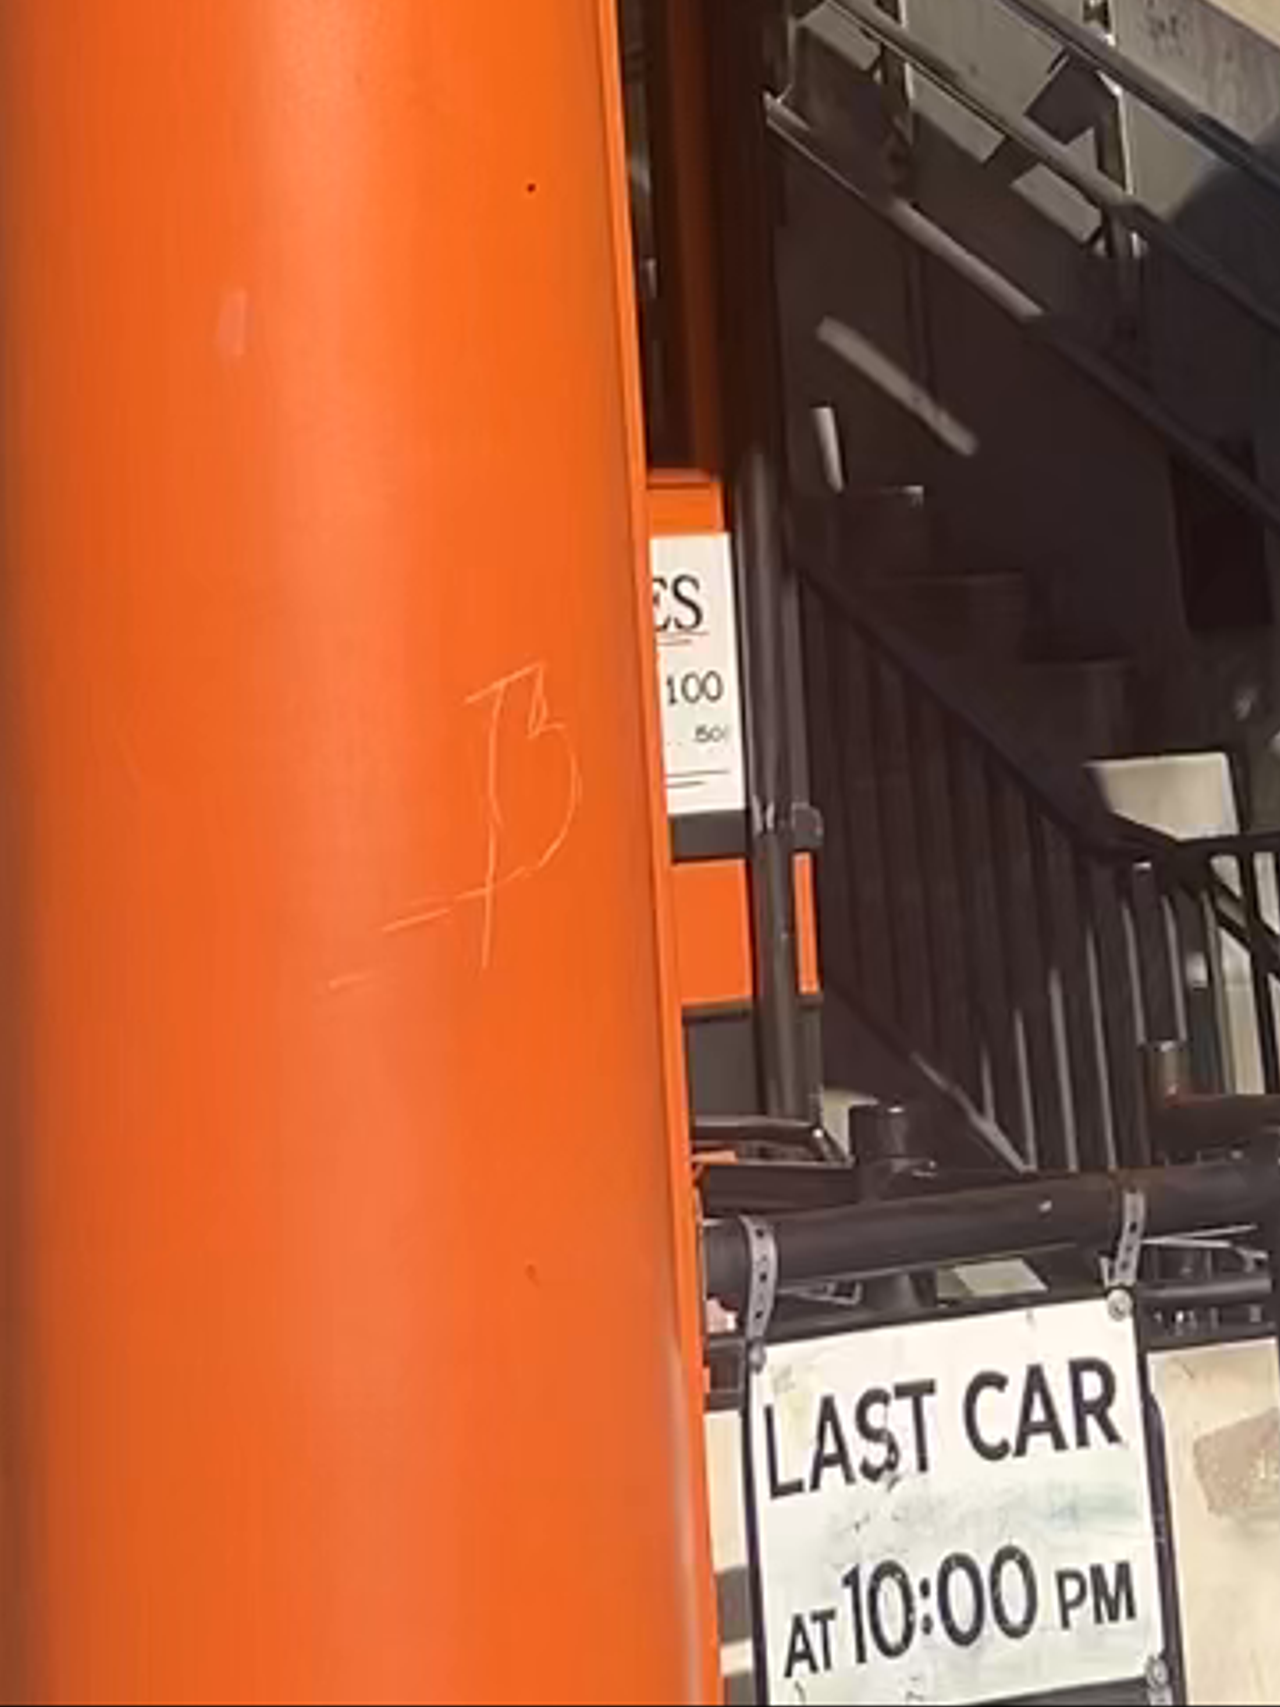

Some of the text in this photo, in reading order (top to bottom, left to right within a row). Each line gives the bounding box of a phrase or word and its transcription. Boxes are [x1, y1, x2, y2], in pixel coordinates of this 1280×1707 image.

[764, 1356, 1124, 1500] LAST CAR
[784, 1543, 1138, 1678] AT 10:00 PM
